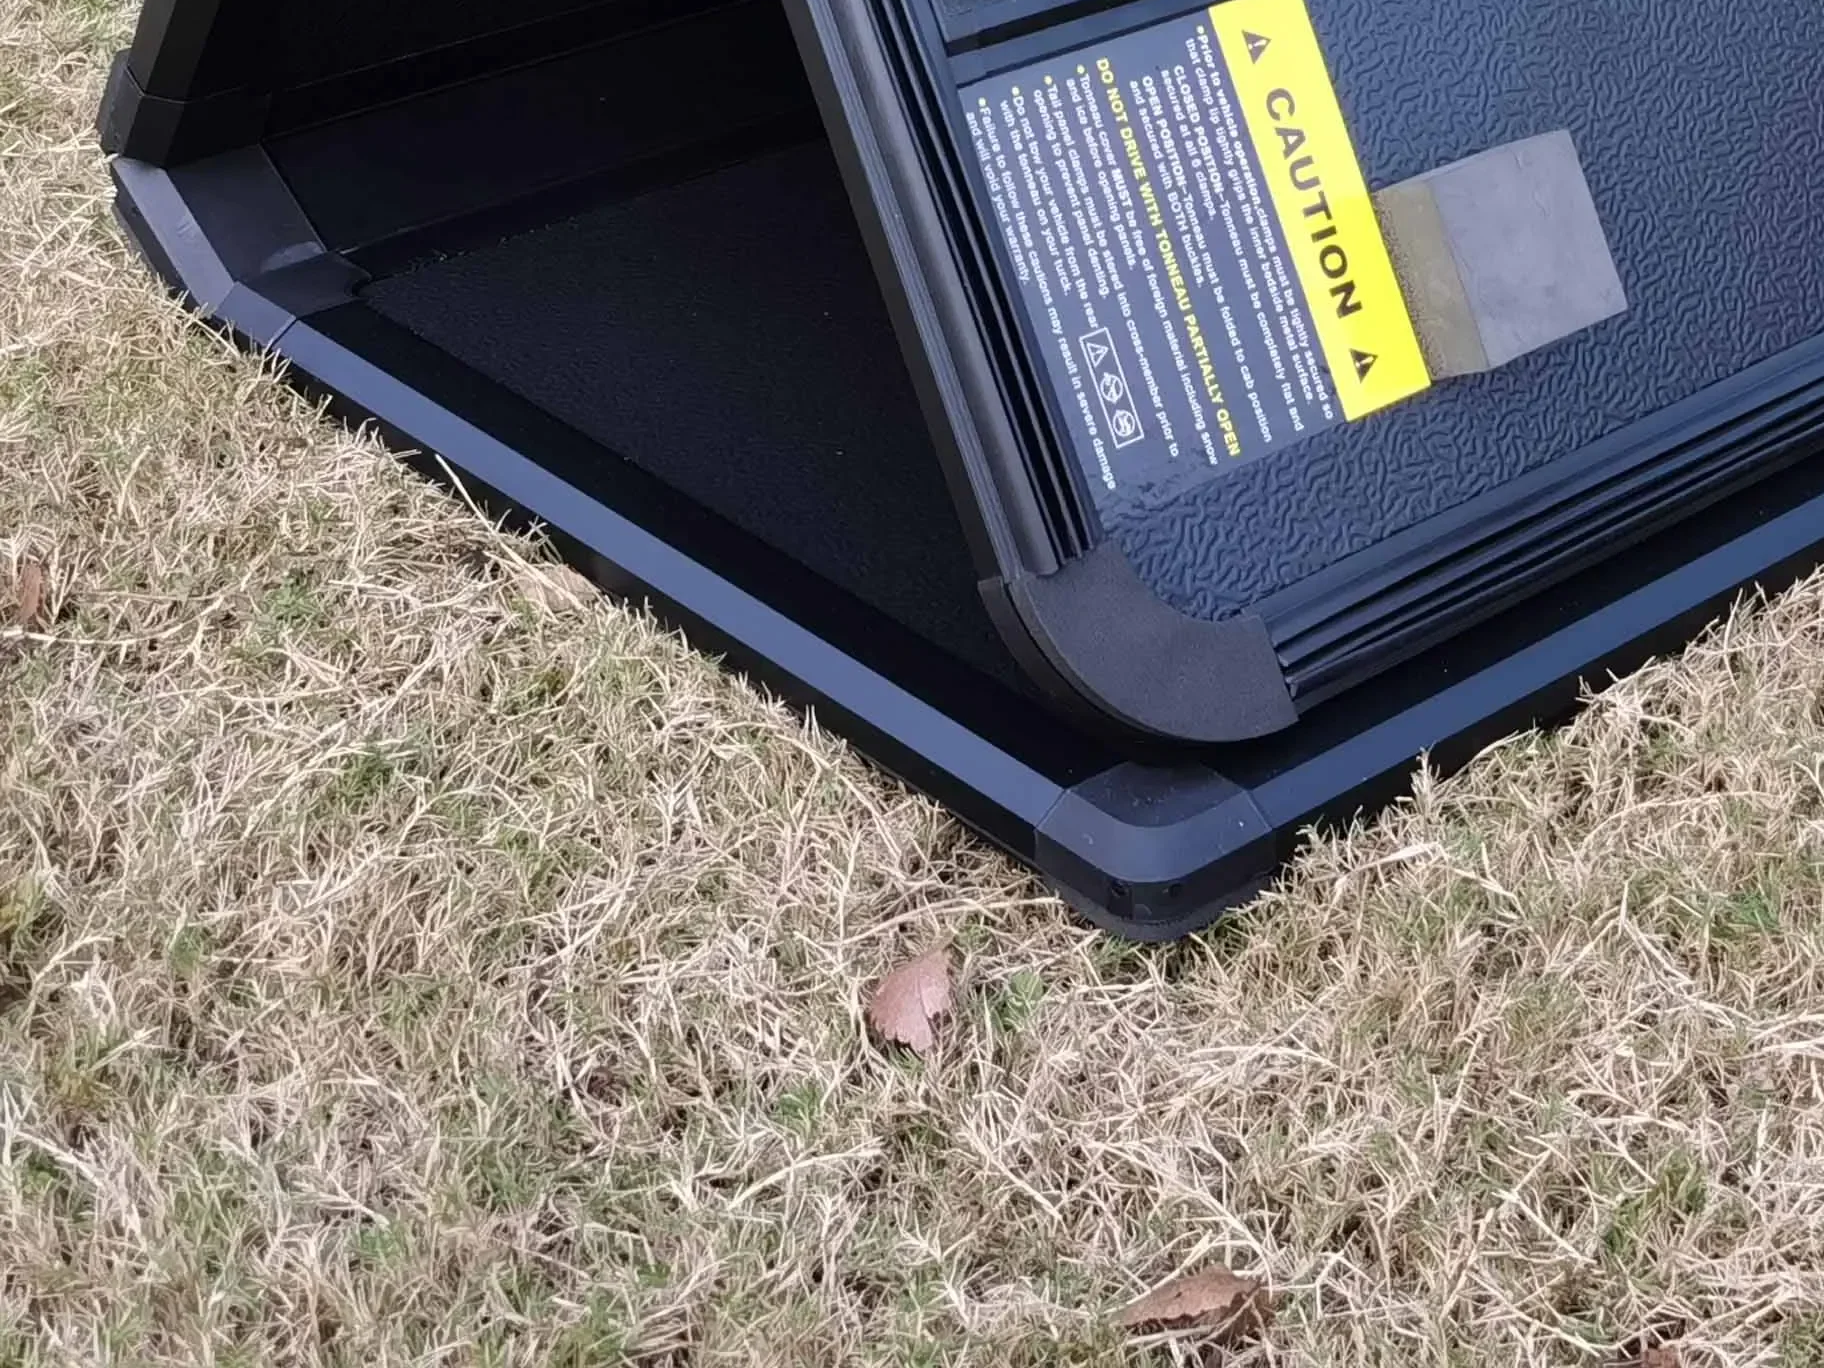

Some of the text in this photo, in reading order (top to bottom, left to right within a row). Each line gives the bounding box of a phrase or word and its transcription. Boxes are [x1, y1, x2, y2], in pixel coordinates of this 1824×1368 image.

[999, 99, 1015, 127] with
[1033, 89, 1056, 140] opening
[1160, 69, 1186, 121] secured
[1179, 123, 1191, 137] at
[965, 111, 982, 136] and
[975, 138, 991, 161] will
[983, 163, 1001, 192] void
[992, 193, 1010, 222] your
[1009, 128, 1023, 151] the
[1017, 152, 1041, 206] tonneau
[1051, 142, 1062, 156] to
[1066, 78, 1082, 103] and
[1075, 104, 1088, 124] ice
[1082, 126, 1102, 168] before
[1097, 170, 1120, 222] opening
[1129, 80, 1145, 104] and
[1138, 107, 1164, 159] secured
[1157, 161, 1172, 189] with
[1167, 191, 1188, 231] BOTH
[1184, 140, 1198, 156] all
[1191, 158, 1201, 168] 6
[1012, 95, 1098, 328] Do not tow your vehicle from the rear
[1036, 208, 1048, 225] on
[1054, 158, 1080, 207] prevent
[1185, 37, 1201, 64] that
[1194, 66, 1213, 105] clamp
[1215, 126, 1234, 165] tightly
[1227, 168, 1246, 201] grips
[1240, 202, 1253, 224] the
[1249, 226, 1266, 259] inner
[1260, 261, 1283, 312] bedside
[1279, 315, 1298, 351] metal
[1266, 88, 1362, 318] CAUTION
[1041, 227, 1059, 256] your
[1071, 209, 1094, 245] panel
[1095, 57, 1240, 456] DO NOT DRIVE WITH TONNEAU PARTIALLY OPEN
[1141, 75, 1163, 116] OPEN
[1201, 251, 1219, 284] must
[1213, 285, 1224, 303] be
[1219, 305, 1241, 346] folded
[1234, 347, 1245, 363] to
[1240, 365, 1254, 389] cab
[1247, 391, 1272, 442] position
[1173, 64, 1200, 123] CLOSED
[1238, 258, 1256, 290] must
[1249, 291, 1261, 308] be
[1256, 311, 1285, 379] completely
[1288, 406, 1304, 431] and
[1197, 34, 1215, 68] Prior
[1209, 71, 1220, 86] to
[1216, 88, 1238, 137] vehicle
[1271, 255, 1290, 287] must
[1283, 288, 1294, 305] be
[1289, 307, 1309, 347] tightly
[1304, 350, 1328, 400] secured
[1322, 403, 1333, 419] so
[979, 106, 1115, 489] Failure to follow these cautions may result in severe damage
[1052, 110, 1075, 146] panel
[1067, 148, 1089, 194] clamps
[1083, 196, 1102, 228] must
[1095, 229, 1107, 247] be
[1101, 249, 1124, 290] stored
[1116, 291, 1131, 317] into
[1125, 319, 1163, 407] cross-member
[1155, 410, 1173, 440] prior
[1168, 442, 1178, 456] to
[1079, 73, 1217, 464] Tonneau cover MUST be free of foreign material including snow
